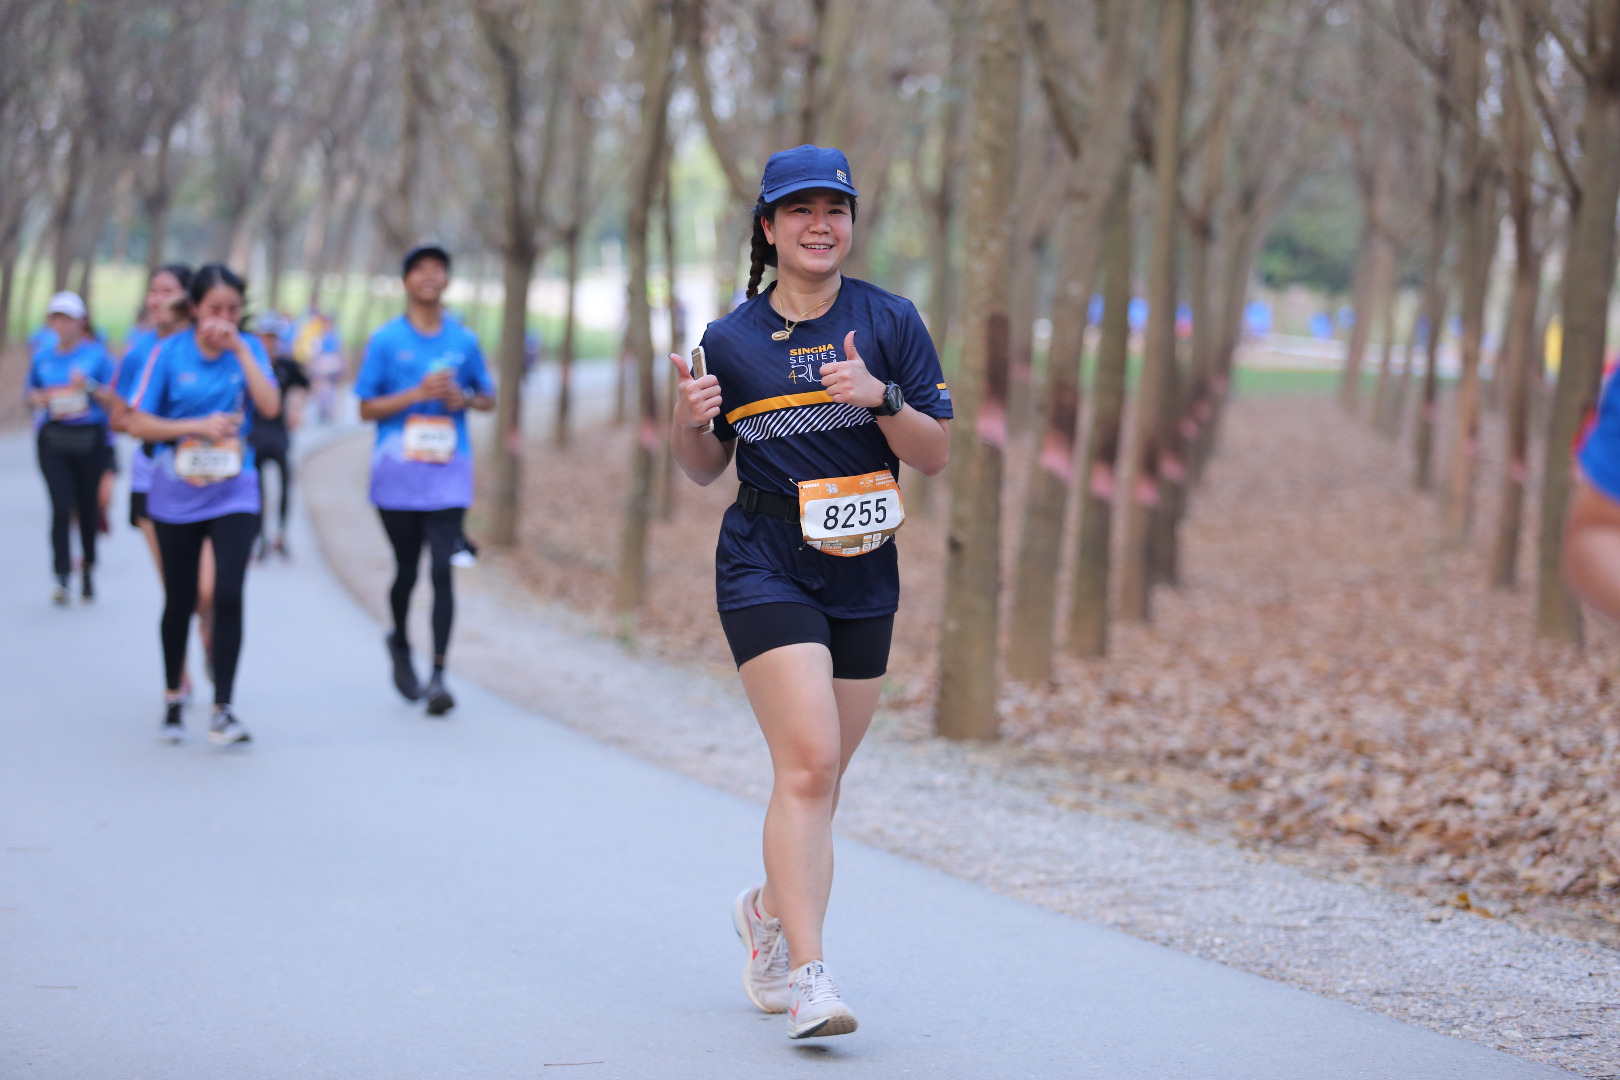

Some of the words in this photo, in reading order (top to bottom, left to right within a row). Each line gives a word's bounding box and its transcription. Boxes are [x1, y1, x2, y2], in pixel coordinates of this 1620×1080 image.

[789, 343, 835, 356] SINGHA
[789, 350, 837, 364] SERIES
[823, 497, 887, 531] 8255
